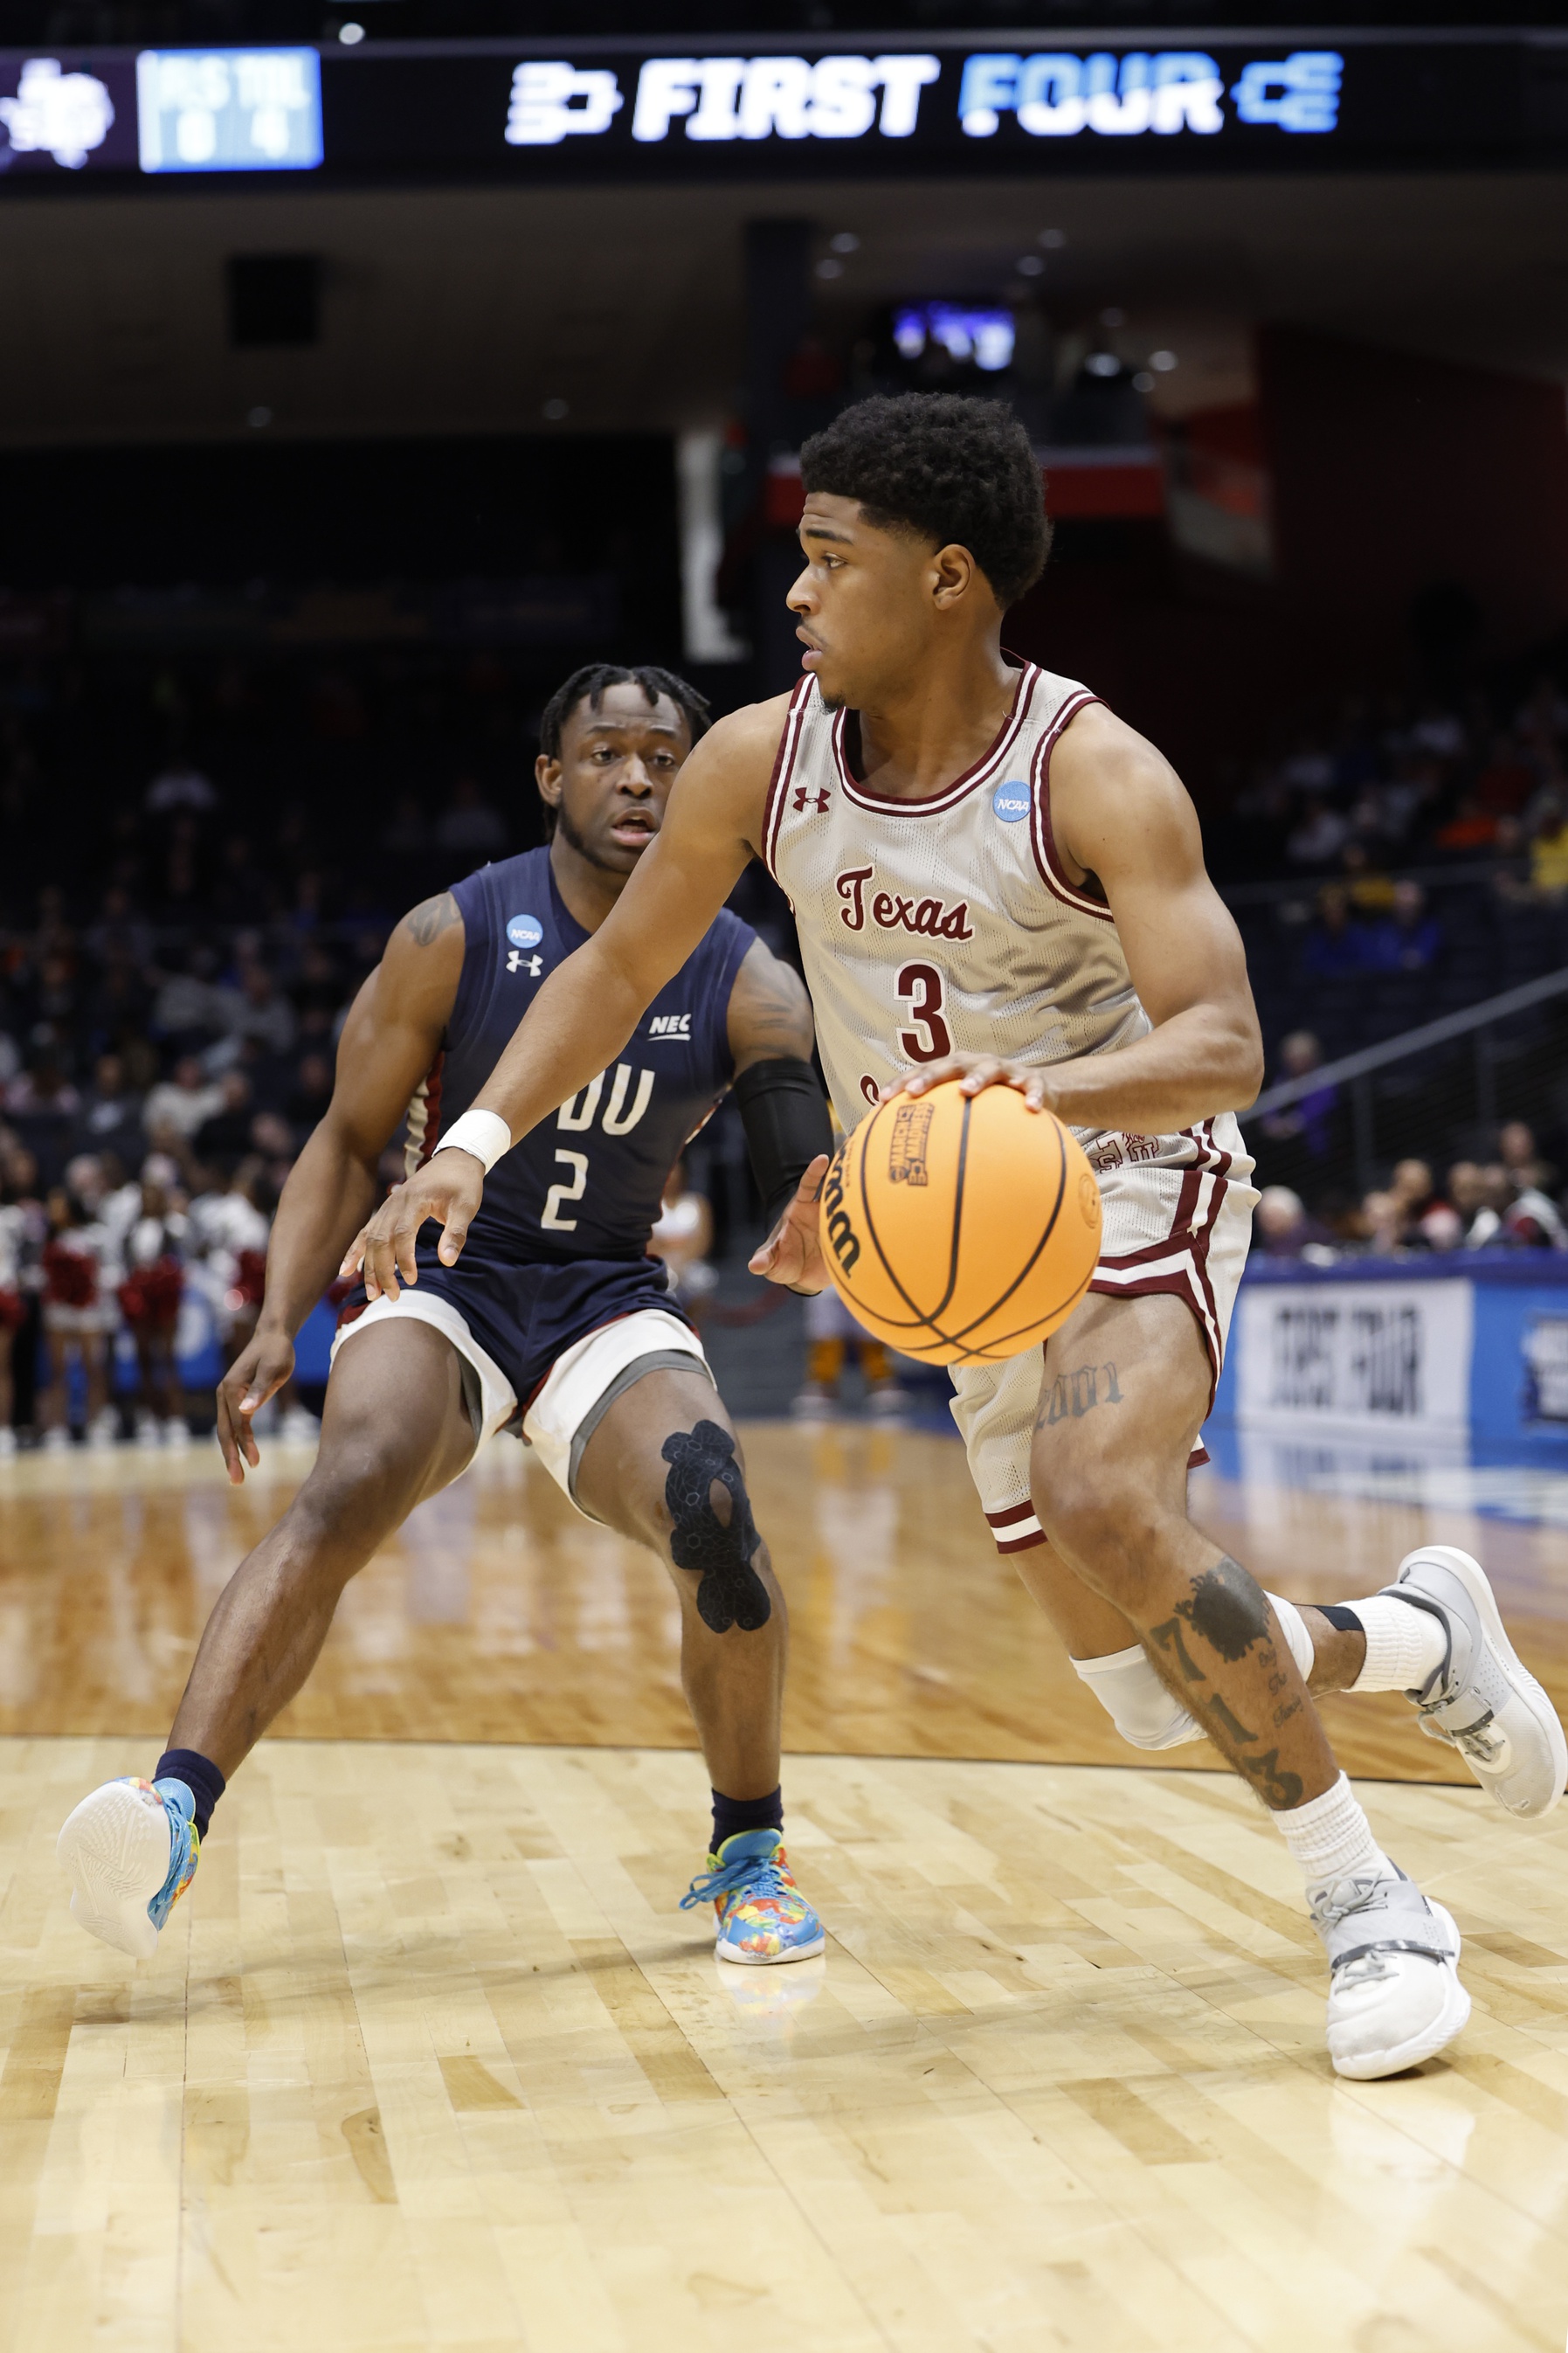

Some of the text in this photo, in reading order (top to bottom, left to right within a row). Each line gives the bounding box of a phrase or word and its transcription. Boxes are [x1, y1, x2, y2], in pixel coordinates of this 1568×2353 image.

[632, 52, 1225, 141] FIRST FOUR
[997, 799, 1029, 812] NCAA
[510, 928, 541, 941] NCAA
[835, 863, 975, 942] Texas
[649, 1014, 692, 1035] NEC
[895, 960, 953, 1064] 3
[556, 1063, 655, 1136] DU
[541, 1148, 590, 1232] 2
